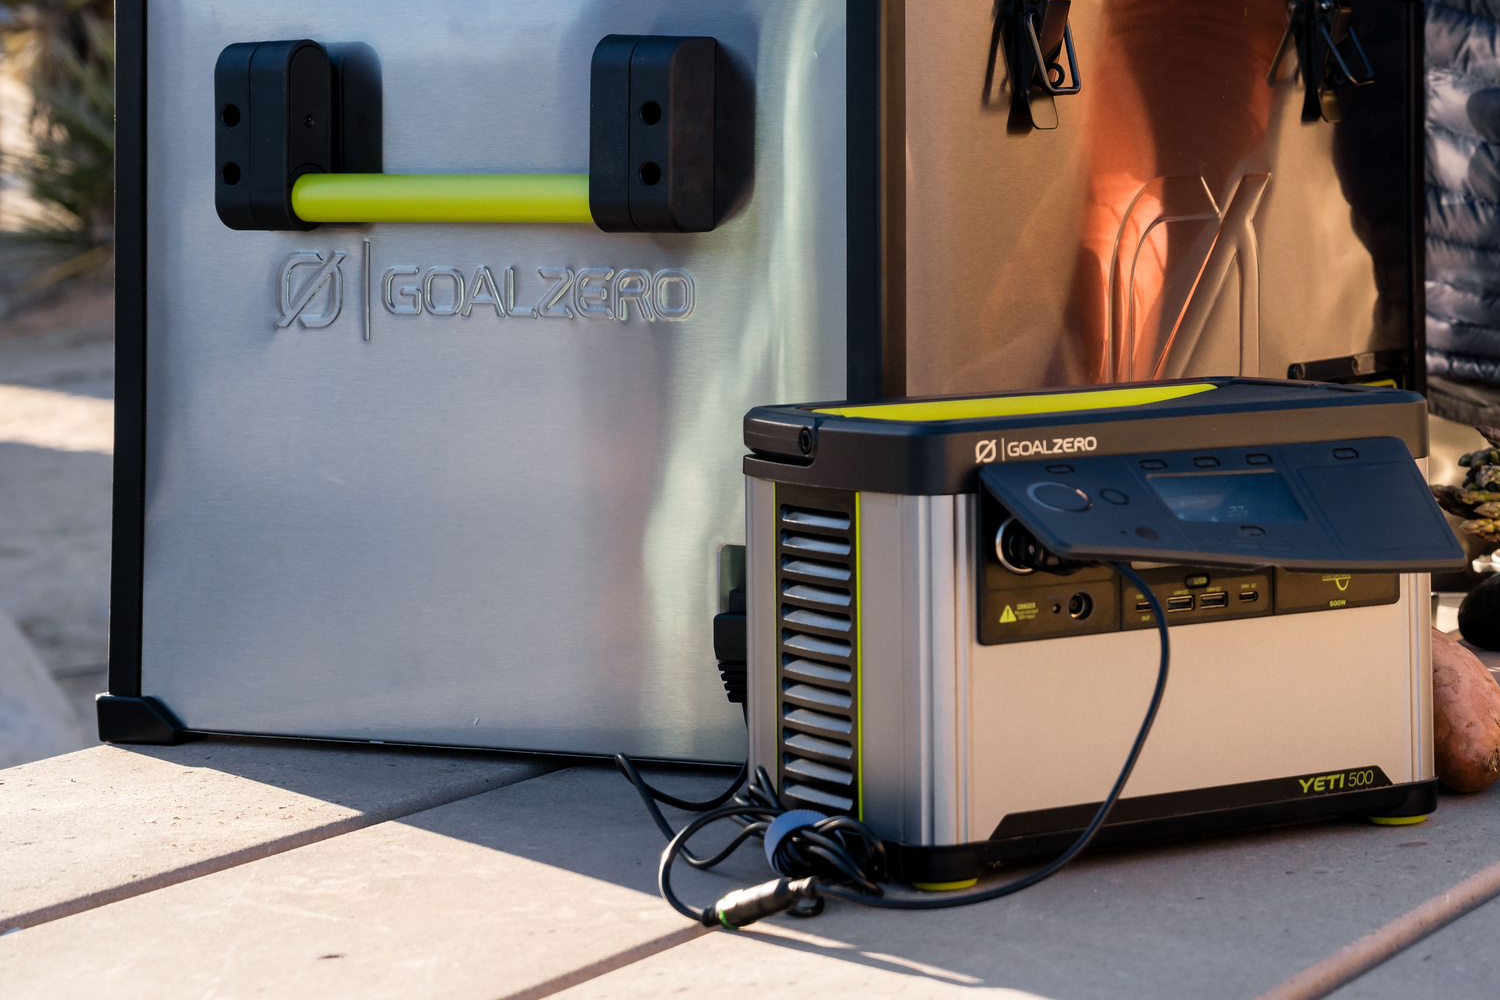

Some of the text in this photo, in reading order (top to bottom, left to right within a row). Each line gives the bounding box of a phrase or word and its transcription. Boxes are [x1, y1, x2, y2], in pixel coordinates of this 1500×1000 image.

[381, 264, 698, 322] GOALZERO
[1007, 436, 1098, 457] GOALZERO
[1299, 769, 1374, 794] YETI 500
